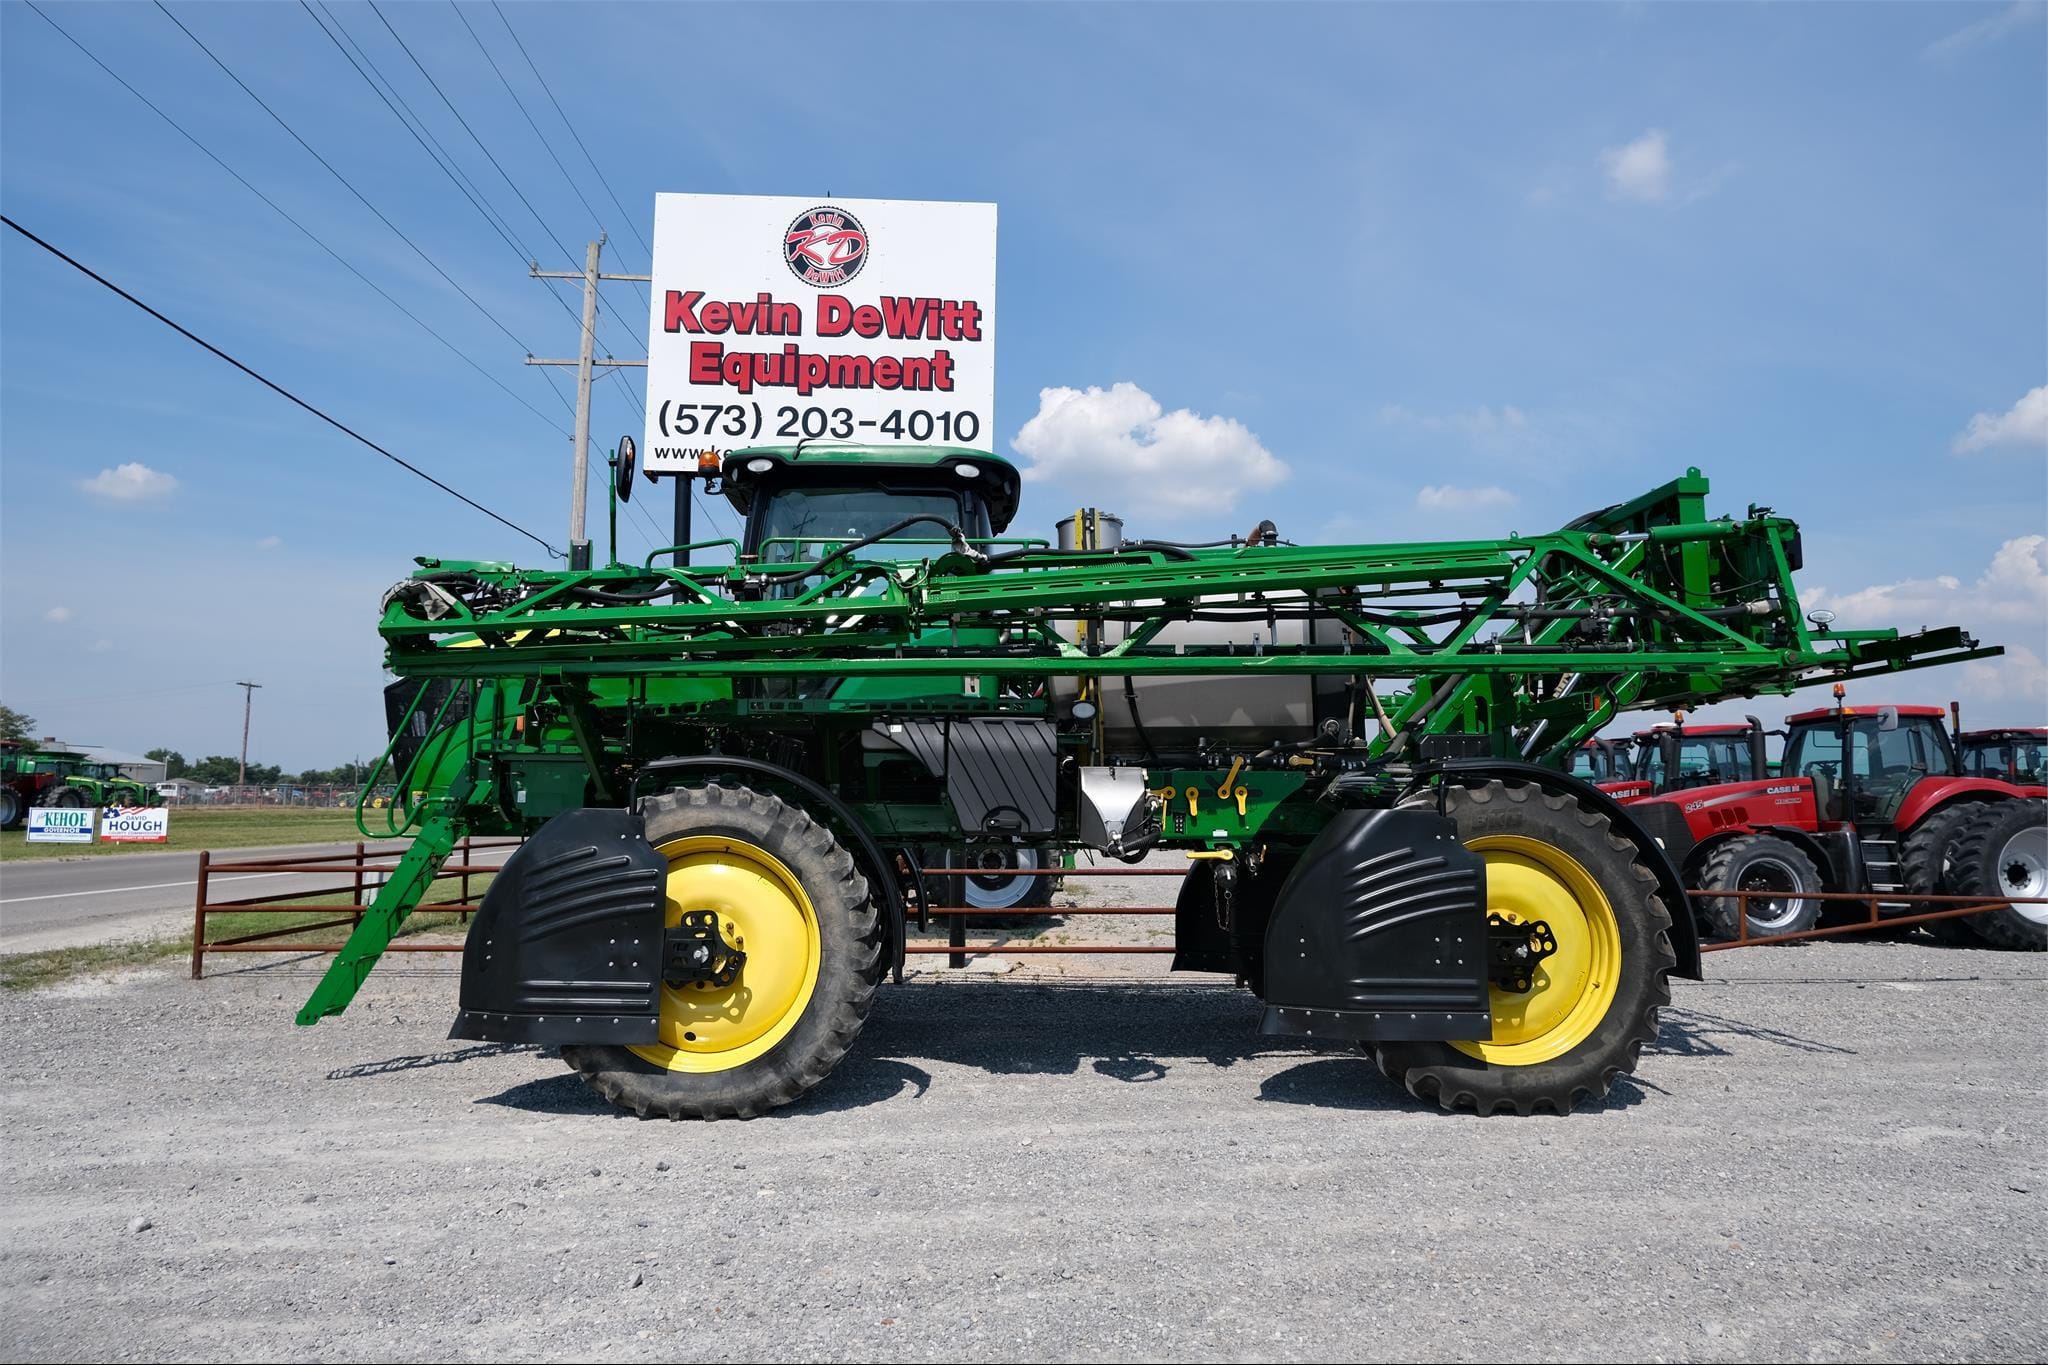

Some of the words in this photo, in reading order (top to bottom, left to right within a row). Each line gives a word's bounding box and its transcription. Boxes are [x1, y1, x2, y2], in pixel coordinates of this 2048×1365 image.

[808, 212, 845, 227] Kevin
[785, 229, 866, 265] KD
[803, 266, 848, 284] DeWitt
[664, 290, 802, 336] Kevin
[817, 294, 982, 341] DeWitt
[689, 341, 955, 396] Equipment
[659, 400, 763, 439] (573)
[776, 407, 980, 442] 203-4010
[1767, 786, 1791, 794] CASE
[1685, 800, 1705, 813] 245
[45, 812, 88, 827] KEHOE
[109, 821, 162, 831] HOUGH
